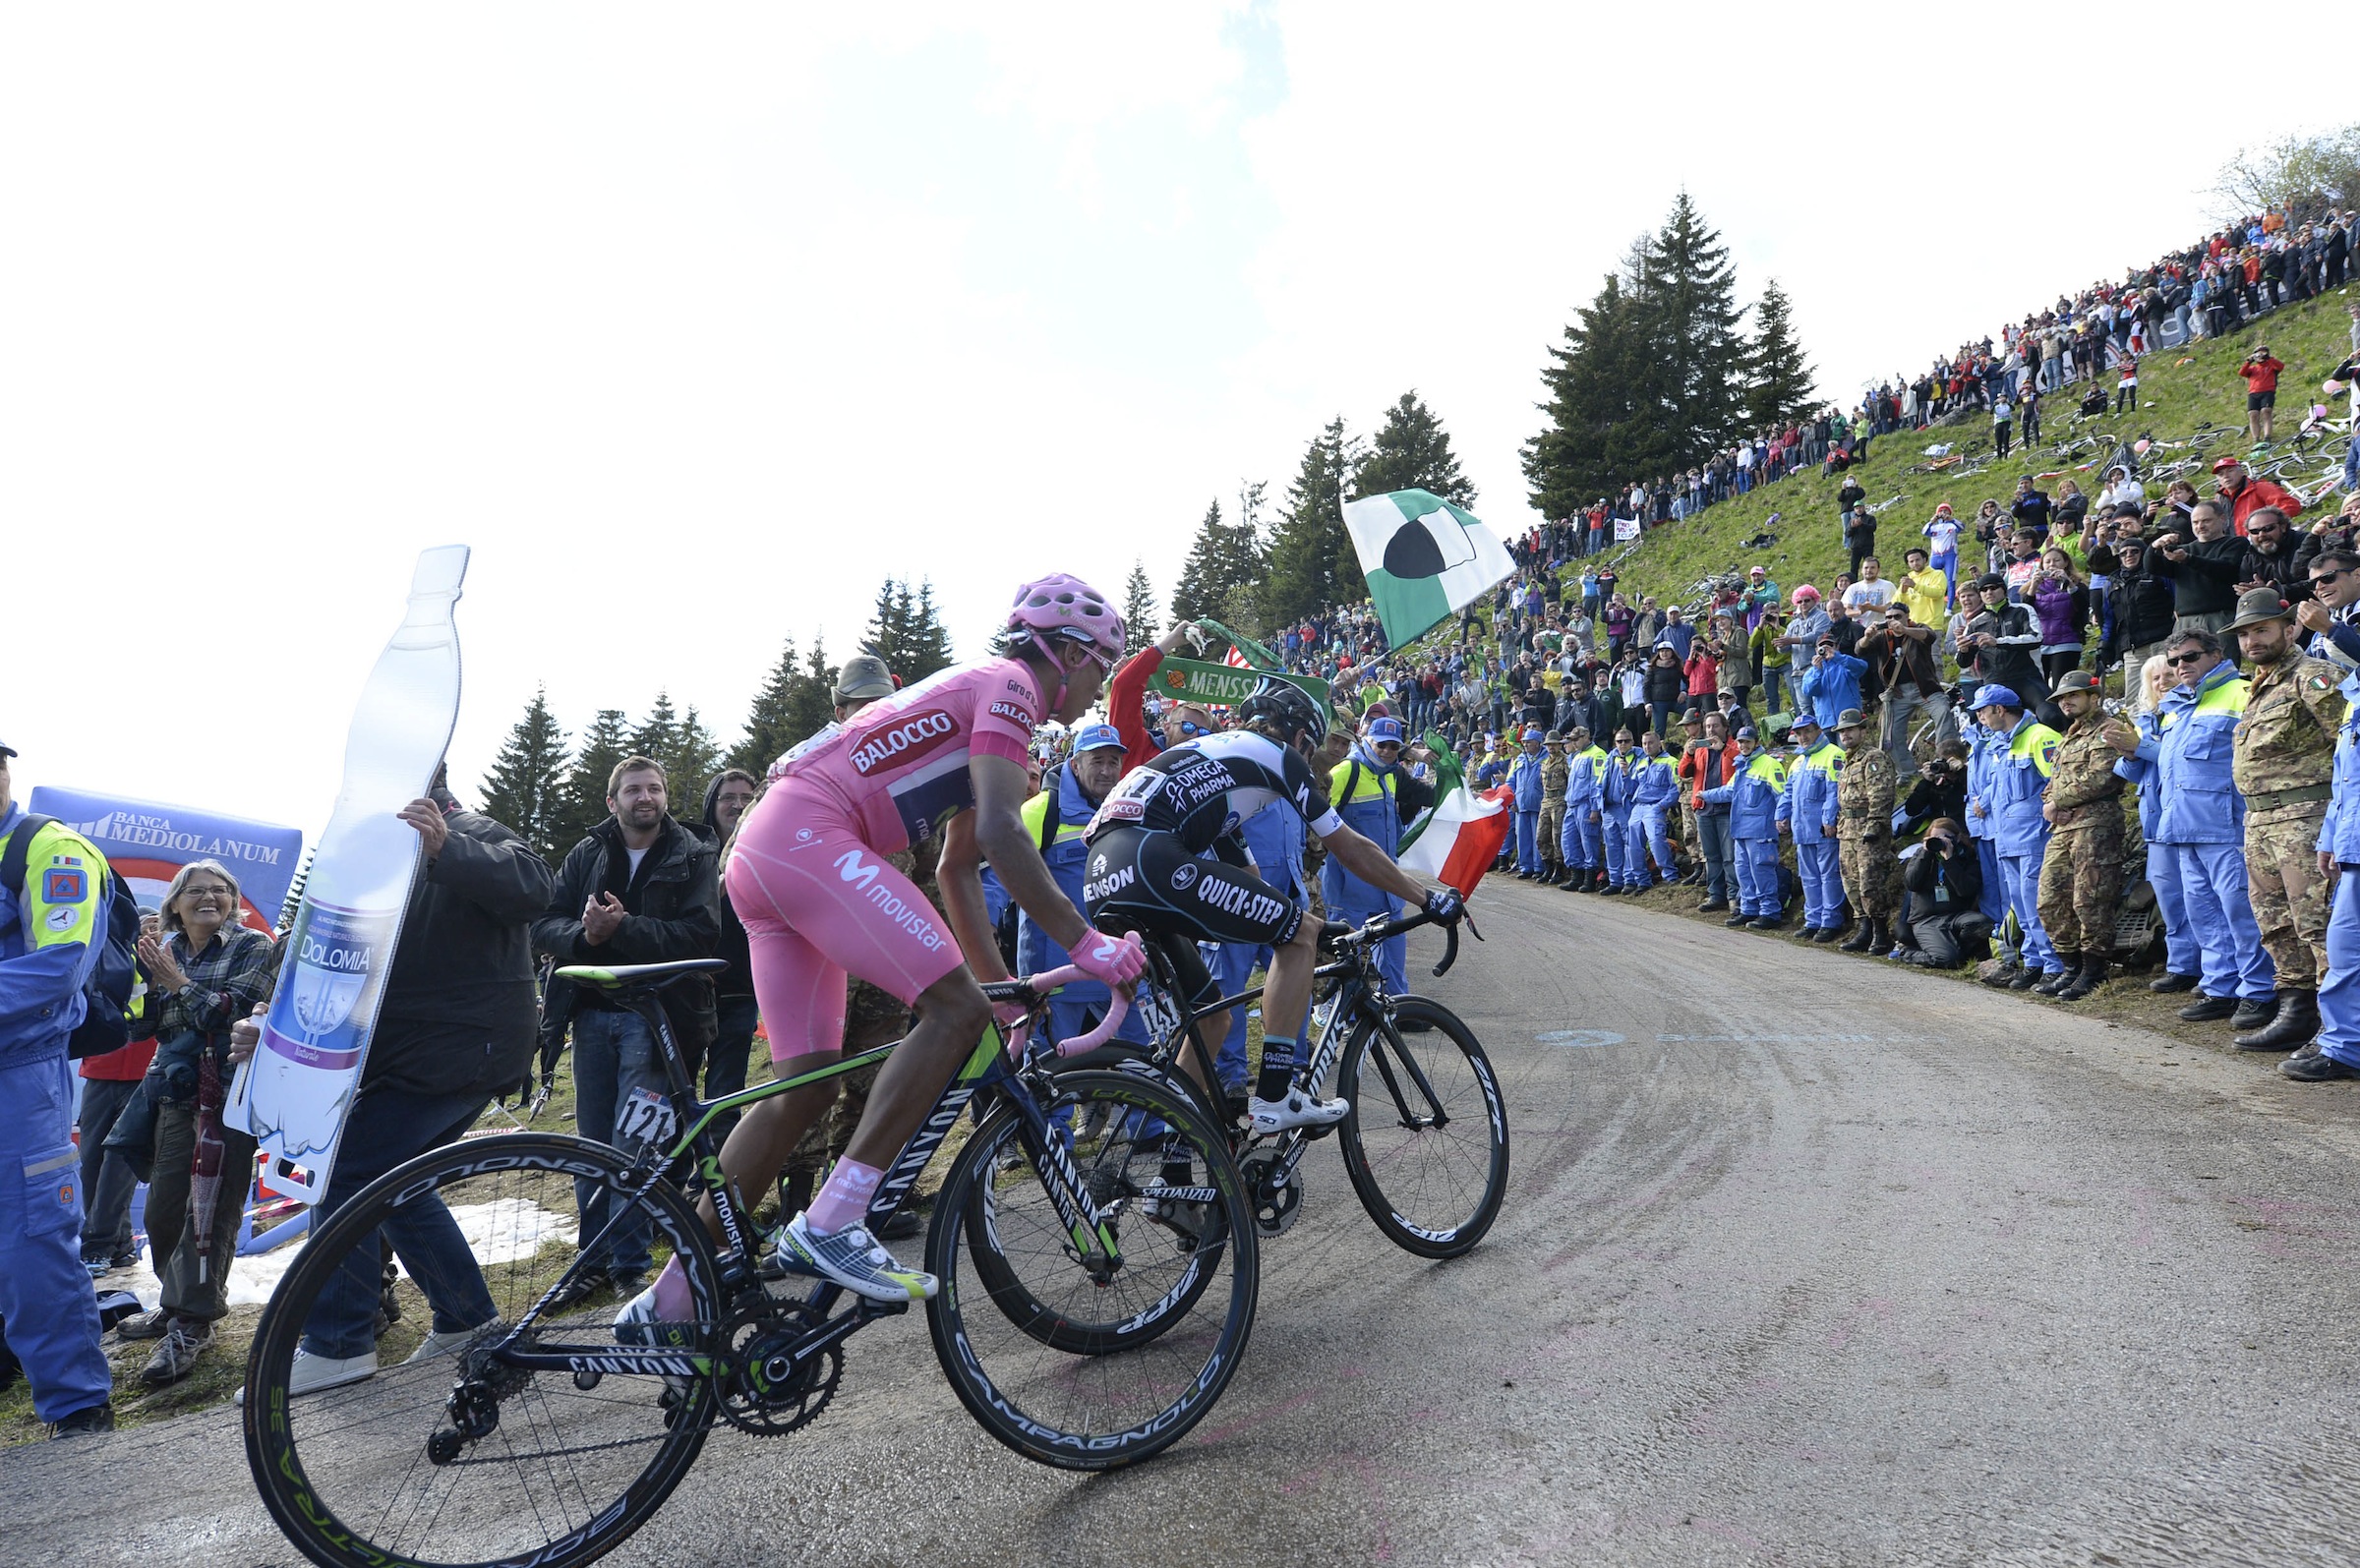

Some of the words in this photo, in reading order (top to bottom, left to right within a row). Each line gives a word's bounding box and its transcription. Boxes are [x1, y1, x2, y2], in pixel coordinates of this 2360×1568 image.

[1070, 612, 1103, 634] movistar
[851, 712, 952, 774] BALOCCO
[1176, 760, 1228, 786] OMEGA
[1189, 774, 1237, 803] PHARMA
[114, 811, 171, 831] BANCA
[109, 822, 281, 865] MEDIOLANUM
[865, 884, 947, 953] movistar
[985, 986, 1016, 997] CANYON
[659, 1023, 676, 1062] CANYON
[1470, 1054, 1503, 1144] ZIPP
[618, 1099, 672, 1145] 121
[1092, 1088, 1210, 1159] ULTRA
[871, 1087, 975, 1213] CANYON
[1038, 1154, 1076, 1229] CANYON
[1044, 1122, 1099, 1229] CANYON
[1141, 1187, 1217, 1202] SPECIALIZED
[1390, 1211, 1458, 1243] ZIPP
[785, 1233, 814, 1266] DIADORA
[1116, 1257, 1200, 1335] ZIPP
[568, 1357, 694, 1376] CANYON
[270, 1385, 284, 1434] 35
[955, 1332, 1222, 1451] CAMPAGNOLO
